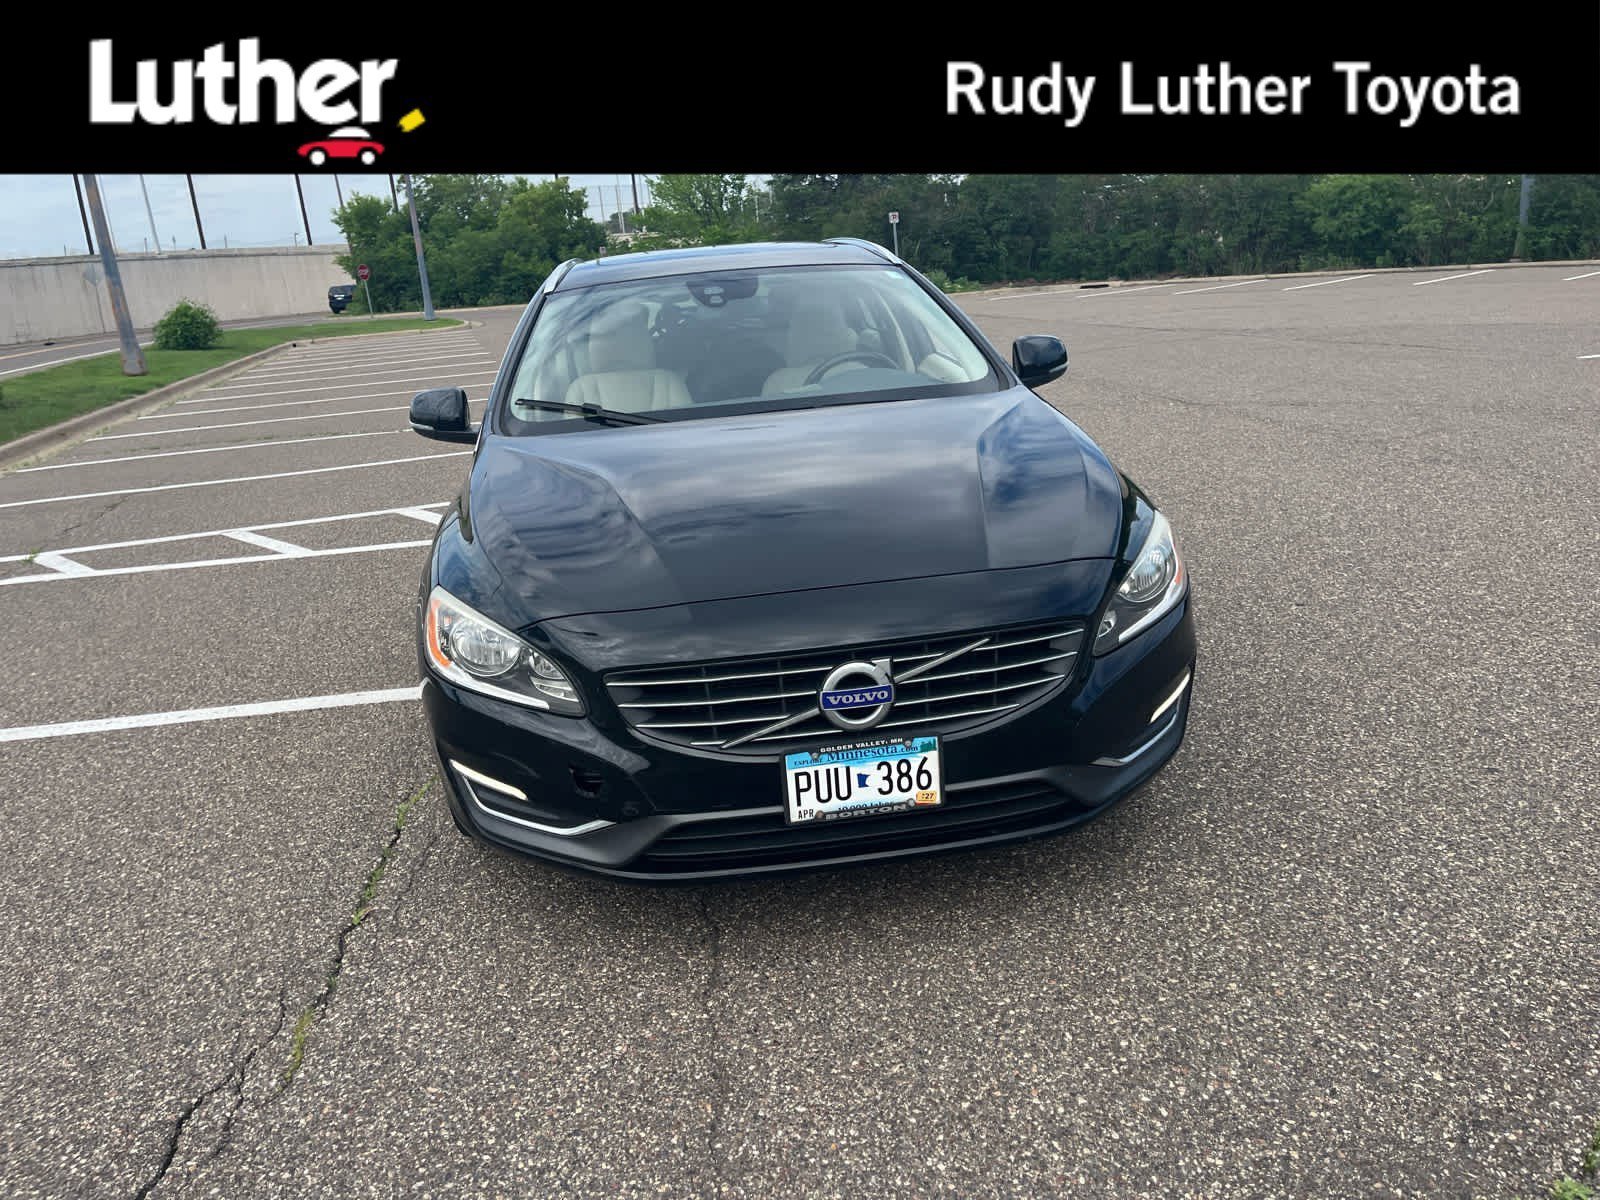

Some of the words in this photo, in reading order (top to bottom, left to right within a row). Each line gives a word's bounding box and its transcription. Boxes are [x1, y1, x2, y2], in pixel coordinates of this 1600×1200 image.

[826, 690, 889, 705] VOLVO
[820, 744, 853, 753] GOLDEN
[794, 766, 853, 807] PUU
[876, 756, 932, 795] 386
[798, 808, 814, 820] APR
